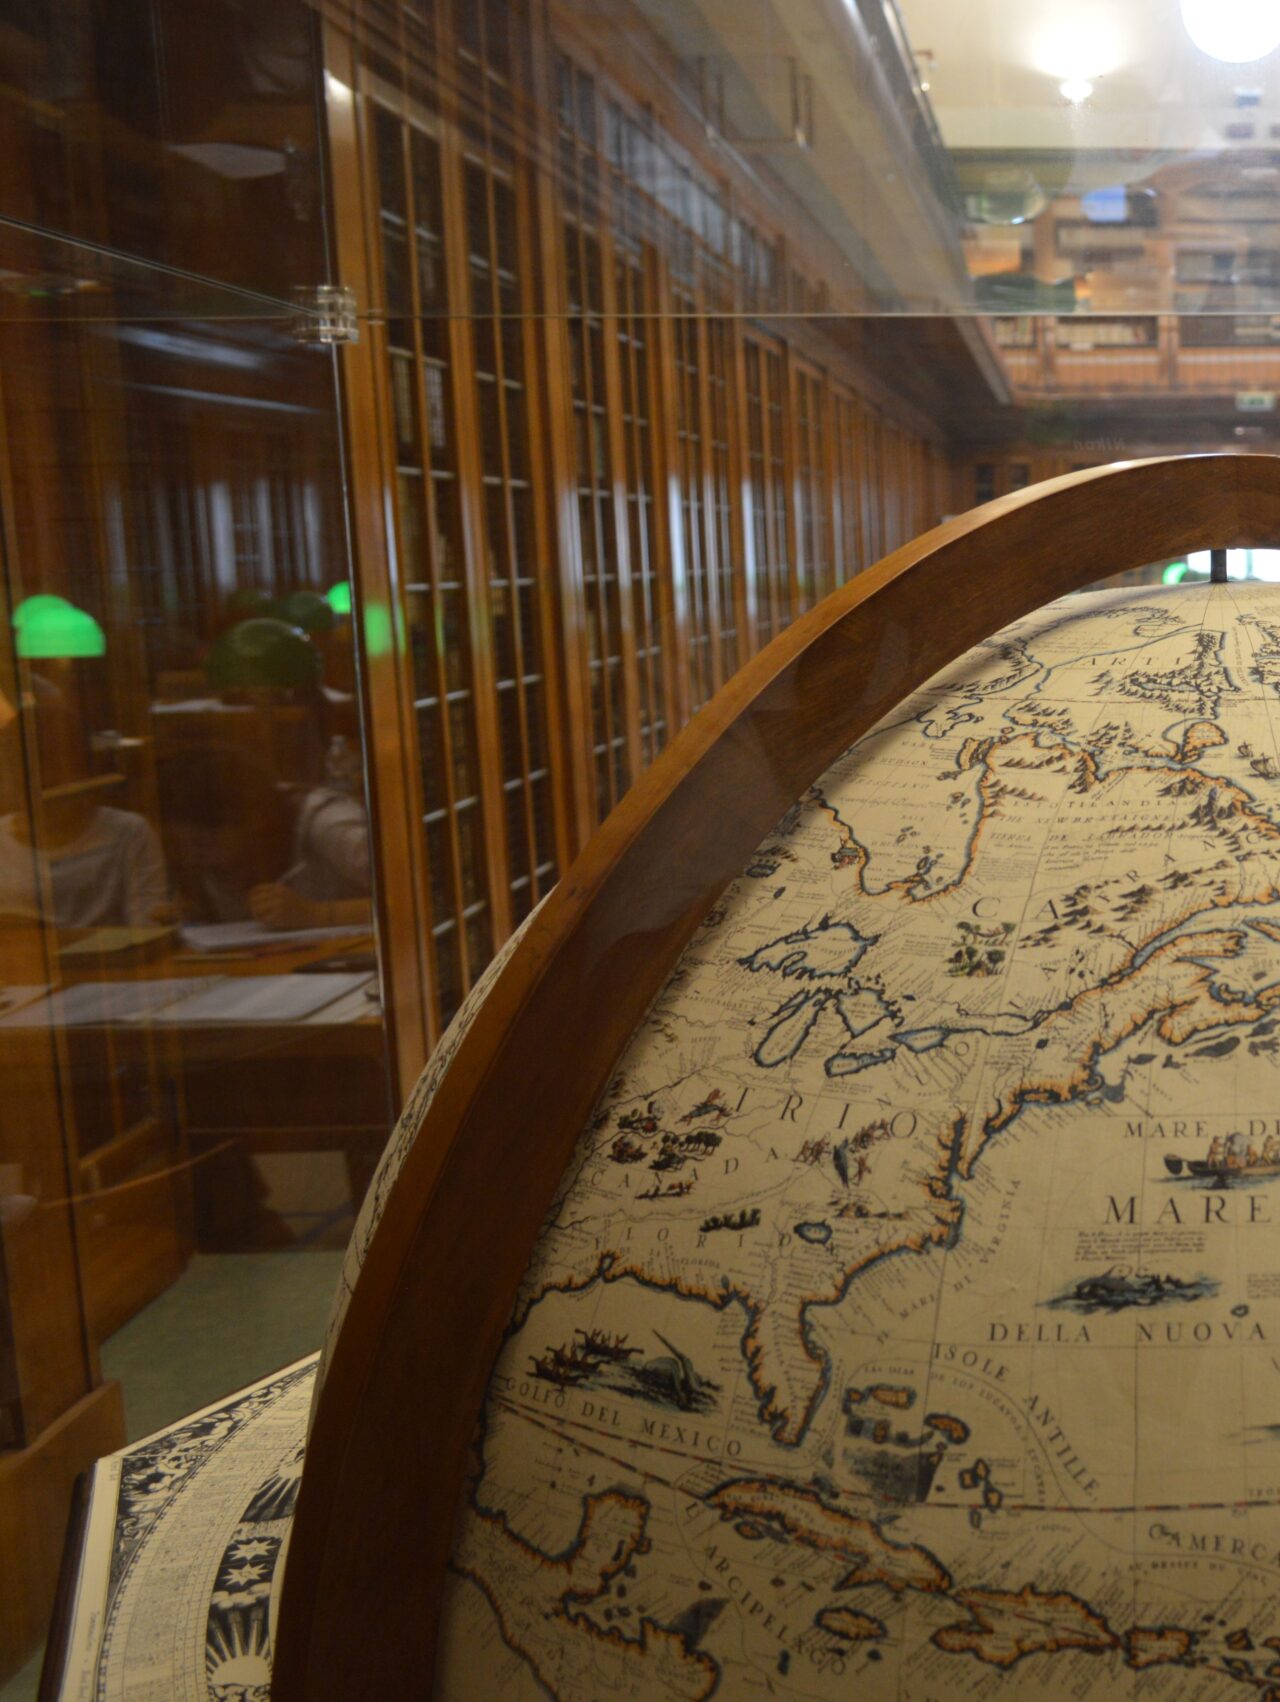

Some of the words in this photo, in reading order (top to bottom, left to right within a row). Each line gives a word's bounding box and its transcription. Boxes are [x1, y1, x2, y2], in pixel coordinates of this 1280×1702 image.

[1124, 1118, 1208, 1138] MARE
[1104, 1195, 1271, 1225] MARE
[989, 1322, 1092, 1344] DELLA
[1137, 1322, 1267, 1343] NUOVA
[933, 1342, 1010, 1383] ISOLE
[506, 1376, 567, 1409] GOLFO
[580, 1400, 622, 1427] DEL
[640, 1418, 744, 1458] MEXICO
